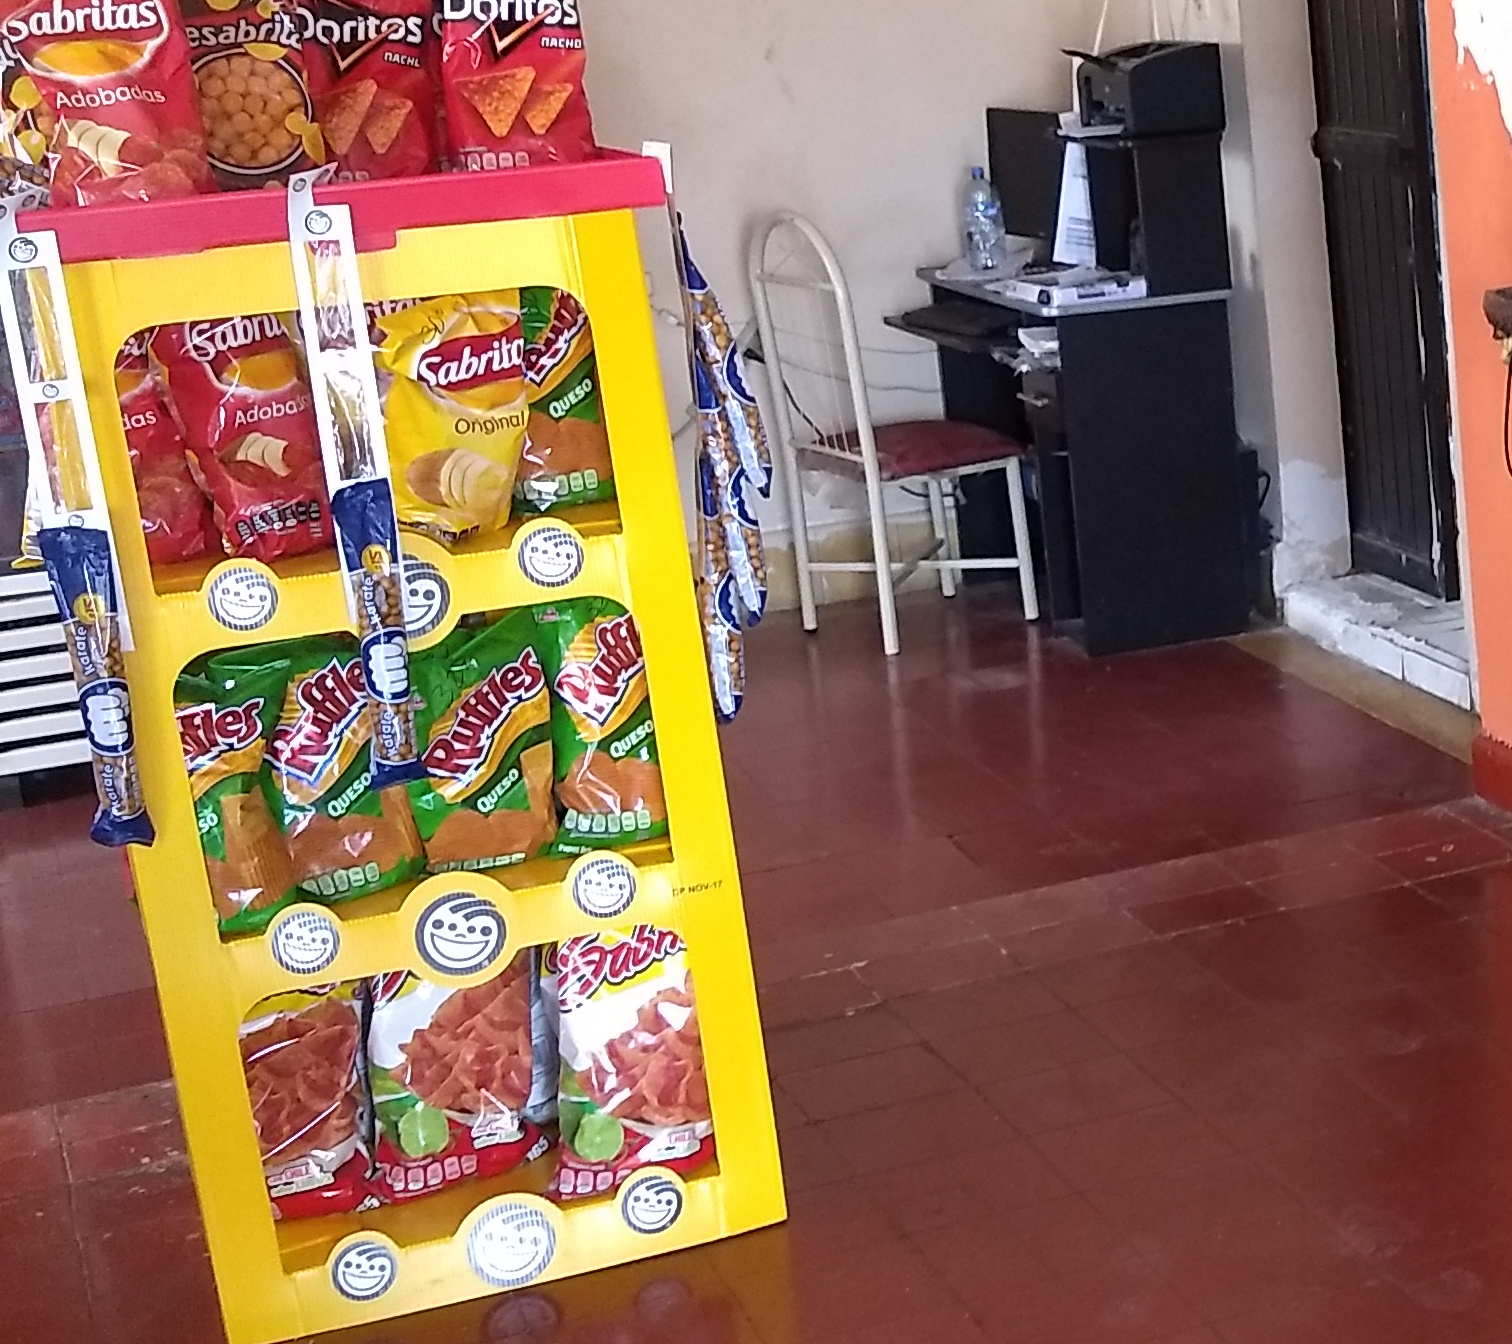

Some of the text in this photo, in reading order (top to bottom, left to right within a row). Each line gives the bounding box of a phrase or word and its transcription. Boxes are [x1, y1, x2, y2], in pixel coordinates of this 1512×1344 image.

[56, 84, 166, 110] Adobadas
[420, 337, 525, 387] Sabrita
[549, 377, 593, 419] QUESO
[455, 410, 525, 436] Original
[75, 625, 95, 676] karate
[267, 659, 366, 780] Ruffle
[422, 647, 544, 777] Ruffles
[610, 719, 654, 757] QUESO
[327, 771, 372, 817] QUESO
[477, 768, 519, 813] QUESO
[688, 879, 723, 893] NOV-17
